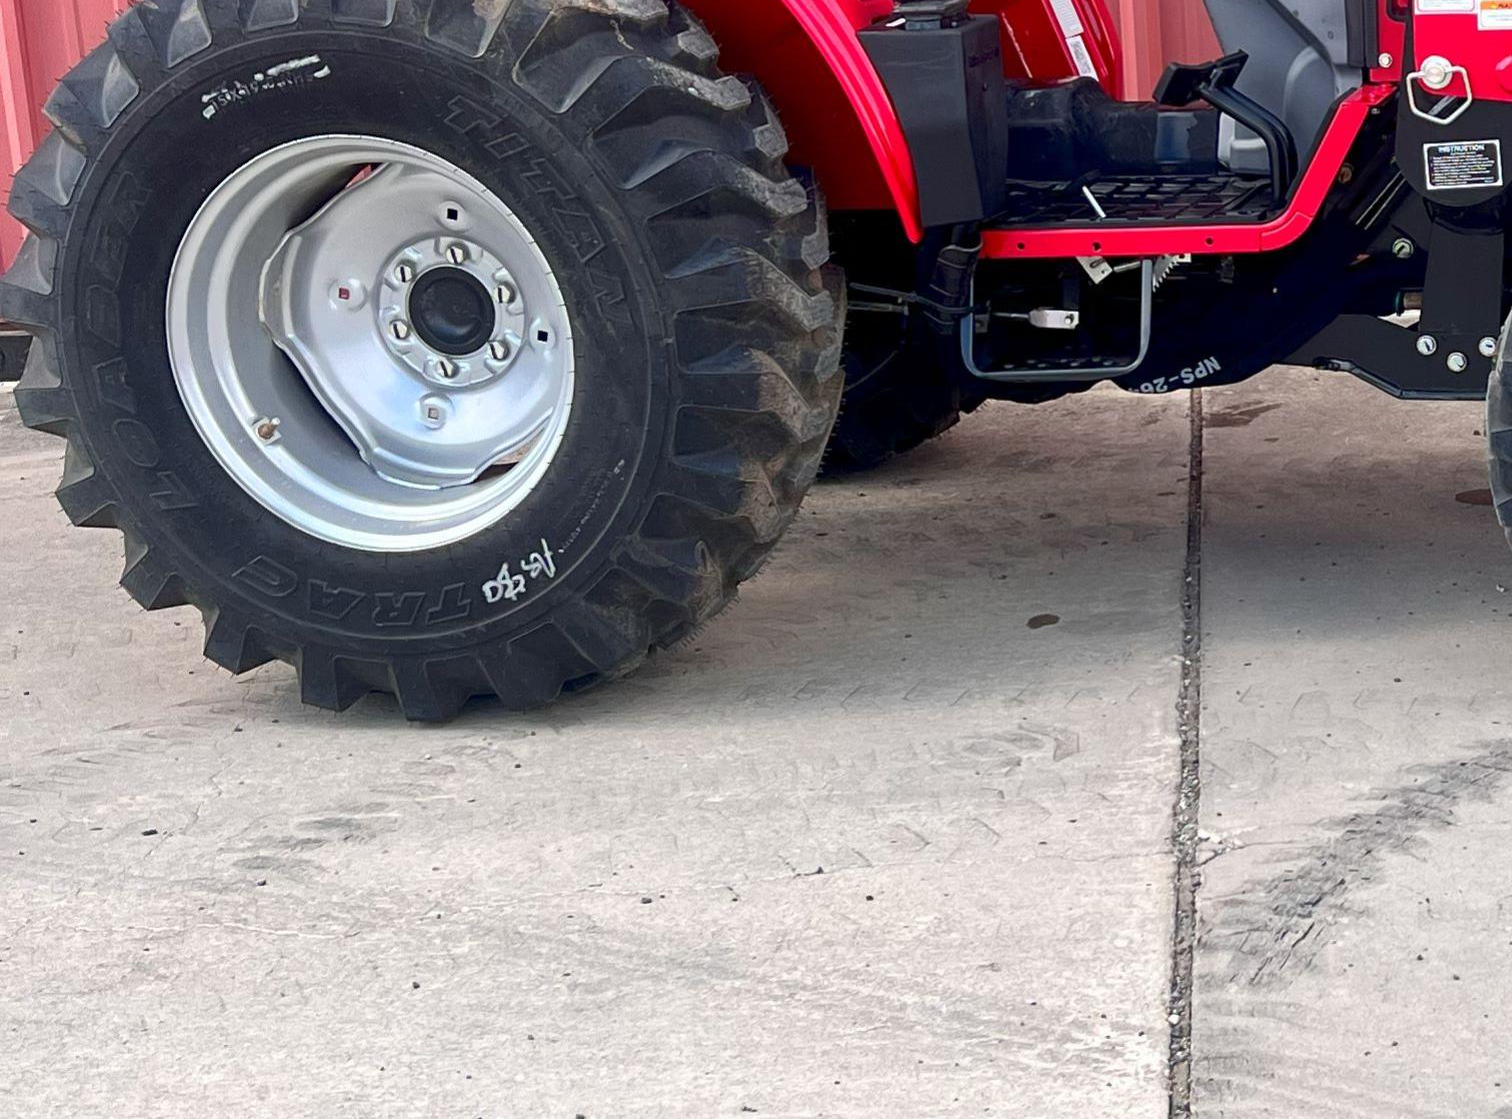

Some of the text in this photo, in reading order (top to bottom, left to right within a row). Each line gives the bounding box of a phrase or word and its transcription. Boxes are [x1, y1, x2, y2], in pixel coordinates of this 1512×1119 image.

[444, 95, 632, 326] TITAN
[86, 171, 472, 627] TRAC LOADER
